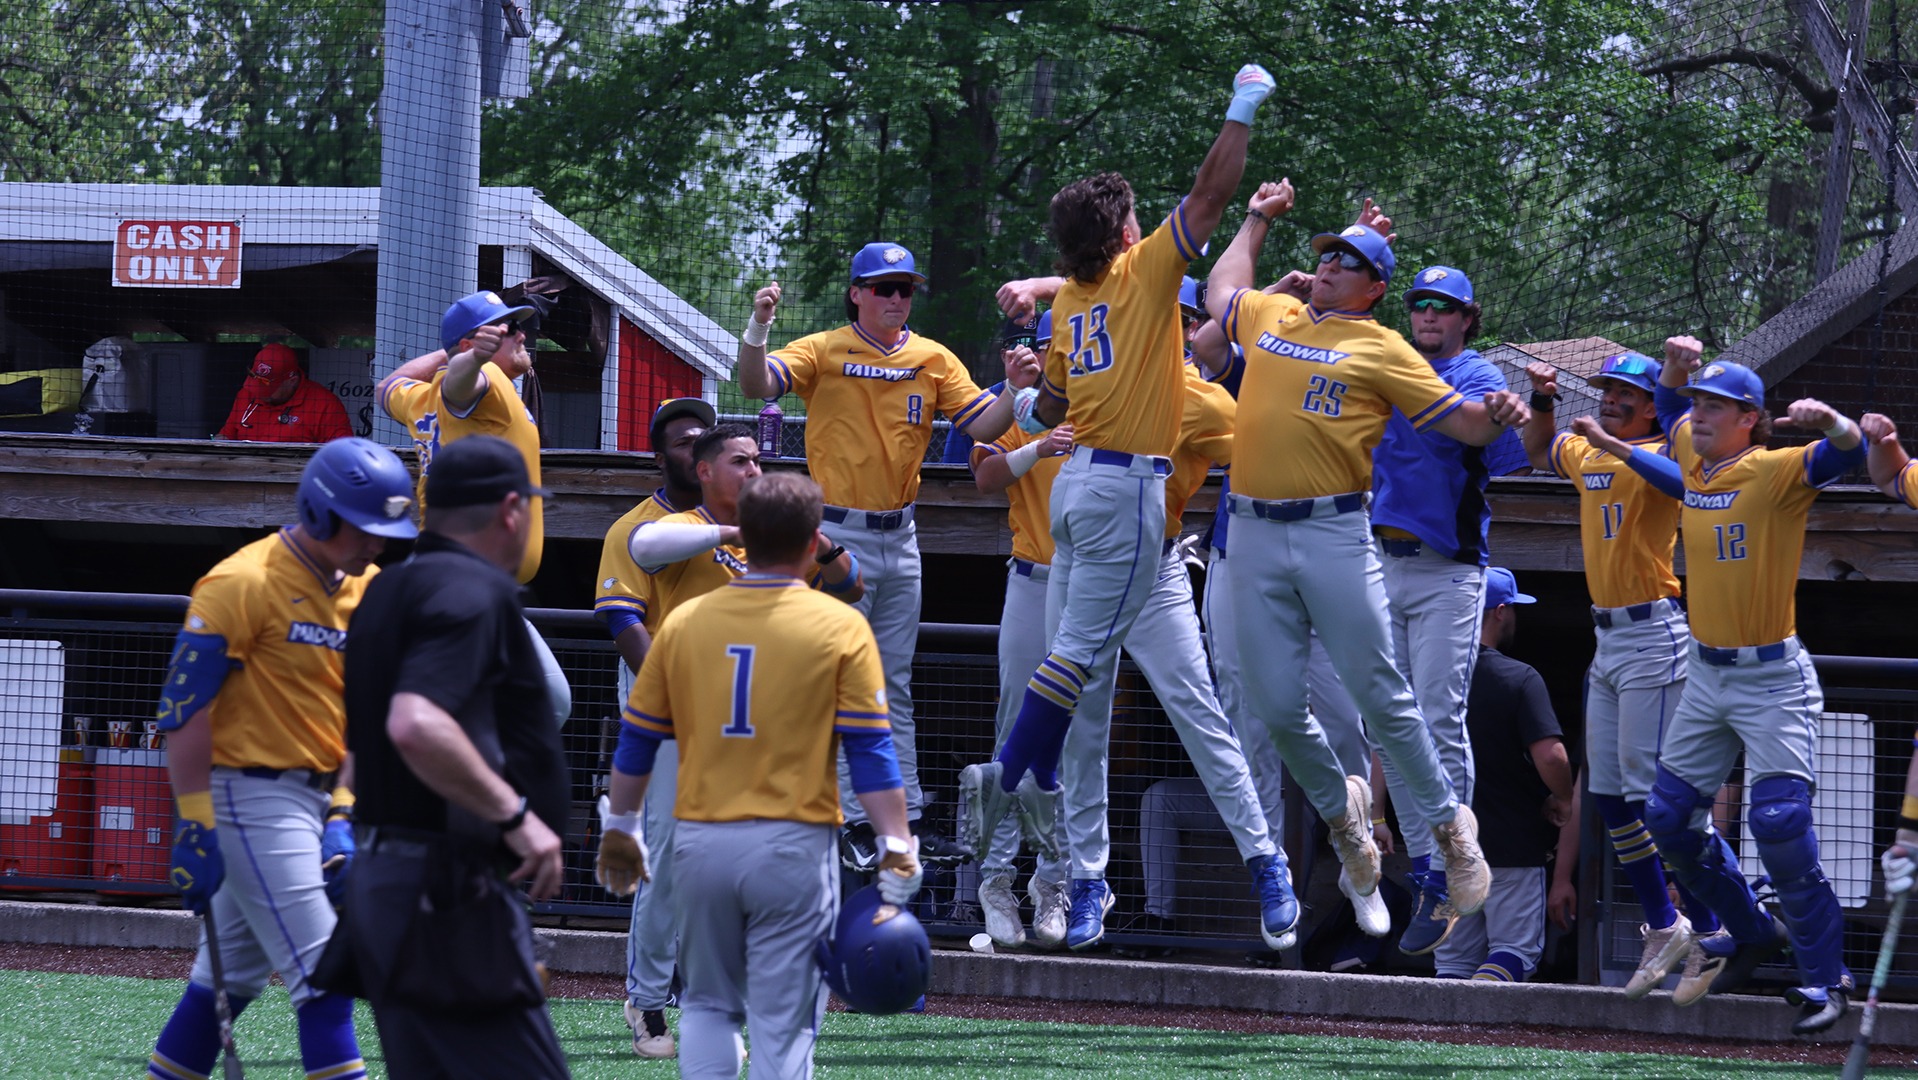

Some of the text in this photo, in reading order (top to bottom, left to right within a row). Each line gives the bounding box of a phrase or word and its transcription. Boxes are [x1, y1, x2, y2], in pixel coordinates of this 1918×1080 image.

[126, 224, 231, 251] CASH
[128, 255, 226, 281] ONLY
[1067, 302, 1114, 377] 13
[1257, 332, 1346, 364] MIDWAY
[906, 393, 924, 425] 8
[1302, 374, 1348, 417] 25
[1684, 490, 1738, 509] IDWAY
[1600, 502, 1623, 540] 11
[1713, 522, 1748, 561] 12
[721, 643, 756, 738] 1
